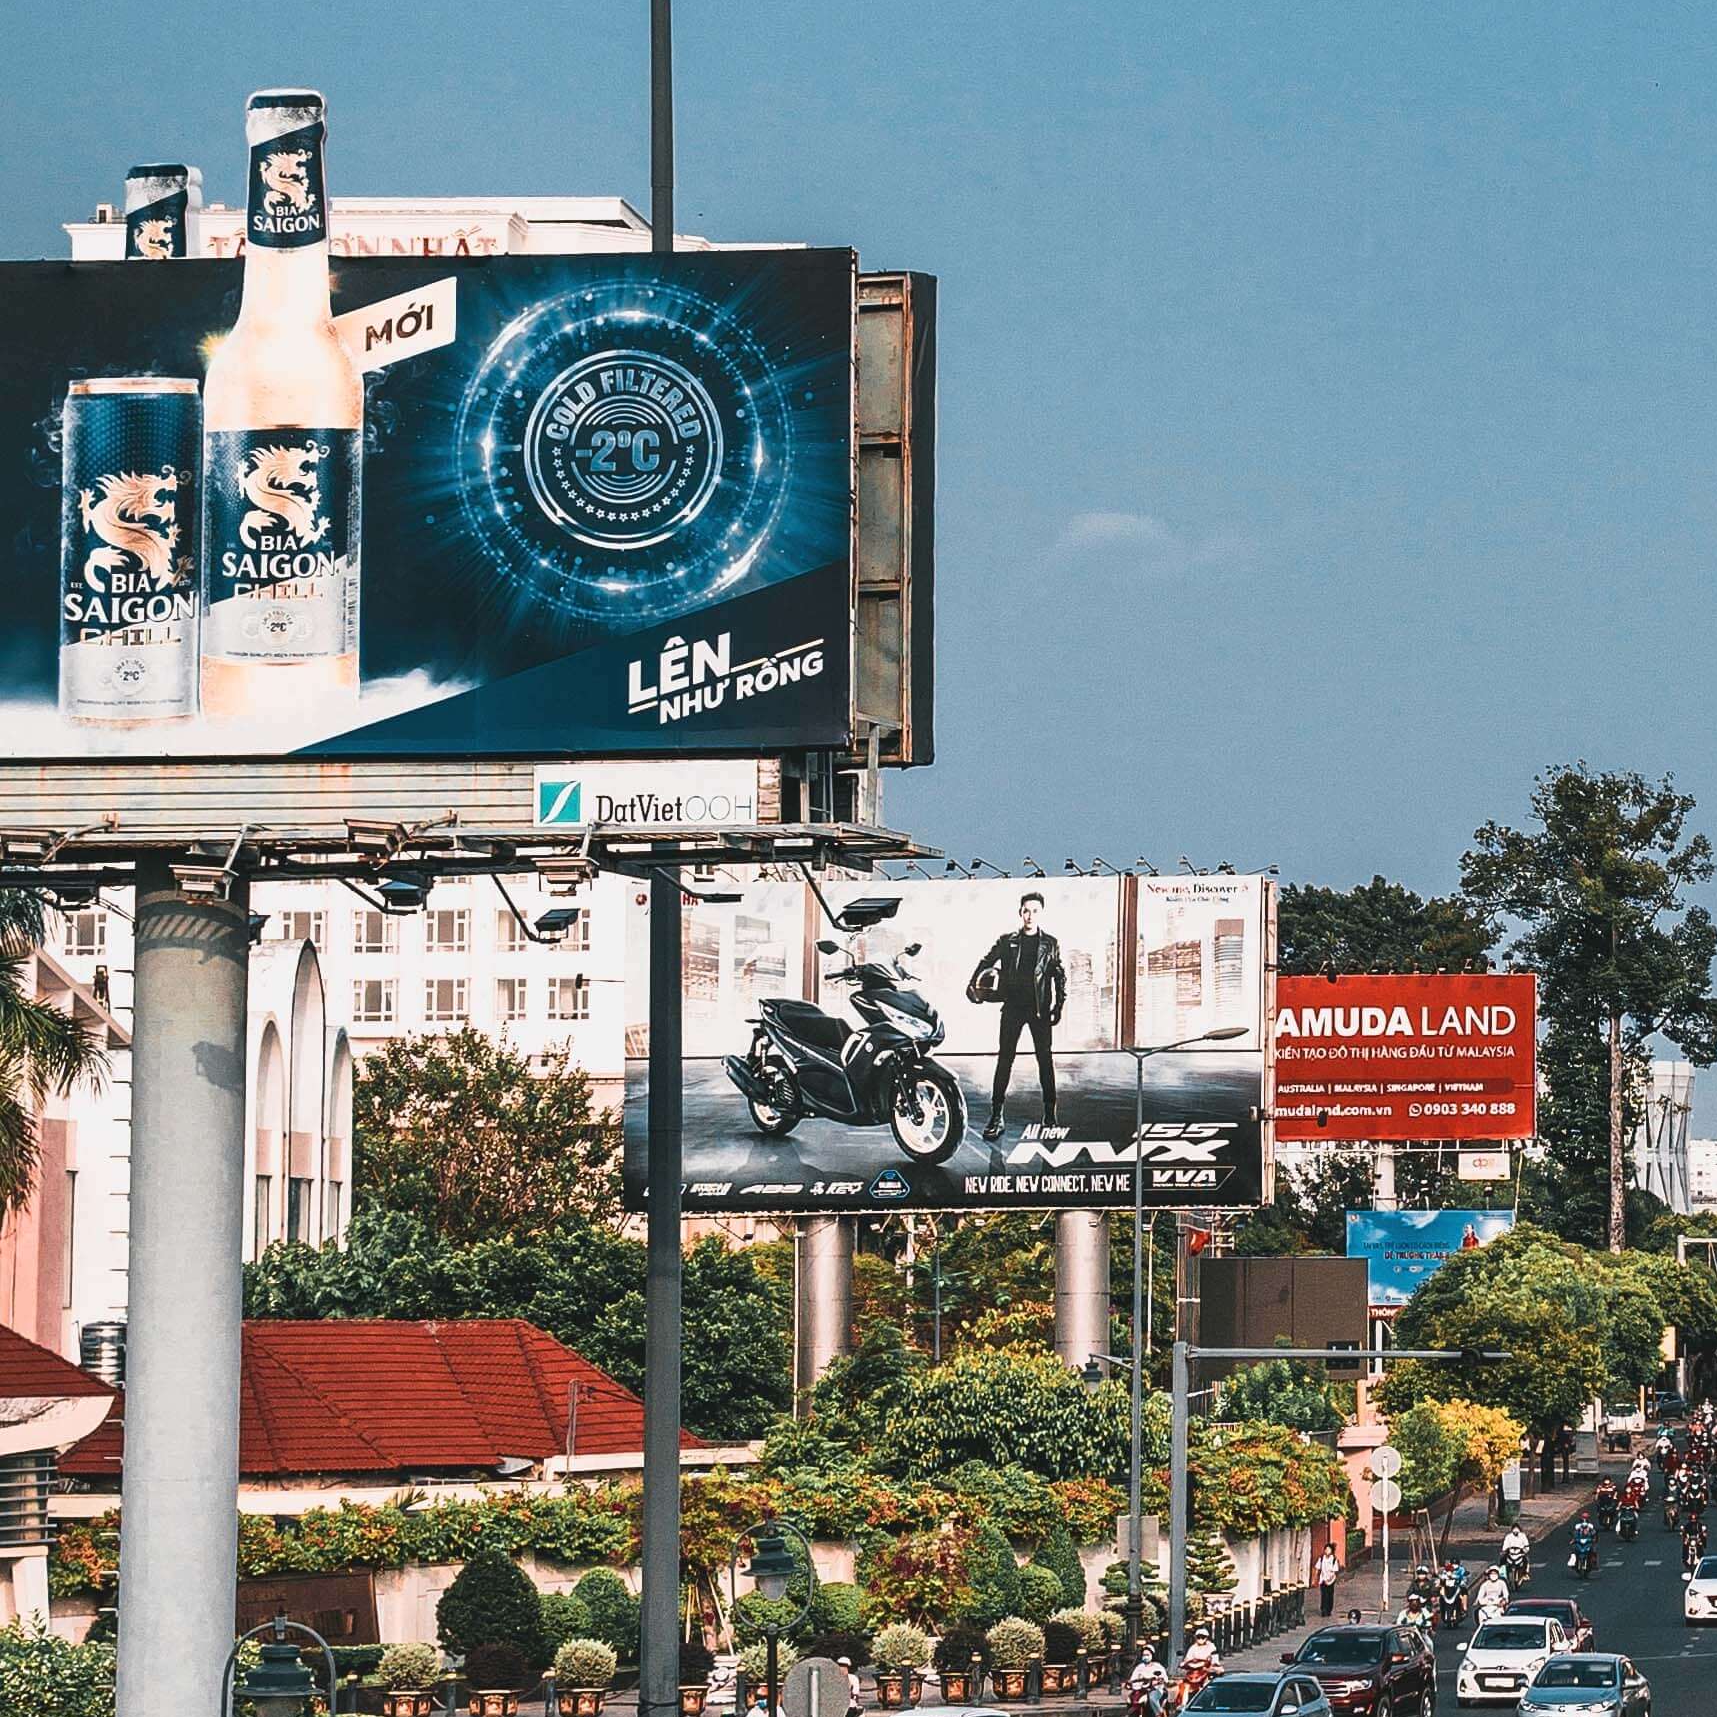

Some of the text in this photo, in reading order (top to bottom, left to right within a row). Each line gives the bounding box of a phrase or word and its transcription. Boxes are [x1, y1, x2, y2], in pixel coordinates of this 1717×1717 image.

[276, 206, 299, 217] BIA
[254, 215, 321, 234] SAIGON
[365, 301, 435, 352] MỚI
[546, 368, 702, 441] COLD FILTERED
[260, 534, 298, 551] BIA
[222, 550, 338, 579] SAIGON
[111, 573, 150, 594] BIA
[233, 582, 324, 600] CHILL
[63, 591, 196, 624] SAIGON
[79, 626, 182, 647] CHILL
[628, 632, 731, 705] LÊN
[659, 650, 824, 725] NHƯ RỒNG
[1420, 1005, 1517, 1036] LAND
[1302, 1047, 1327, 1063] TẠO
[1328, 1045, 1348, 1060] ĐÔ
[1350, 1048, 1370, 1061] THỊ
[1371, 1044, 1407, 1059] HÀNG
[1456, 1045, 1516, 1059] MALAYSIA
[1277, 1083, 1326, 1094] AUSTRALIA
[1333, 1083, 1378, 1094] MALAYSIA
[1386, 1082, 1436, 1093] SINGAPORE
[1423, 1103, 1458, 1116] 0903
[1460, 1103, 1487, 1115] 340
[1490, 1102, 1516, 1115] 888
[1020, 1123, 1071, 1140] All new
[965, 1176, 988, 1194] NEW
[1015, 1175, 1040, 1194] NEW
[1091, 1175, 1114, 1193] NEW
[1116, 1174, 1132, 1192] ME
[1152, 1169, 1217, 1183] VVA
